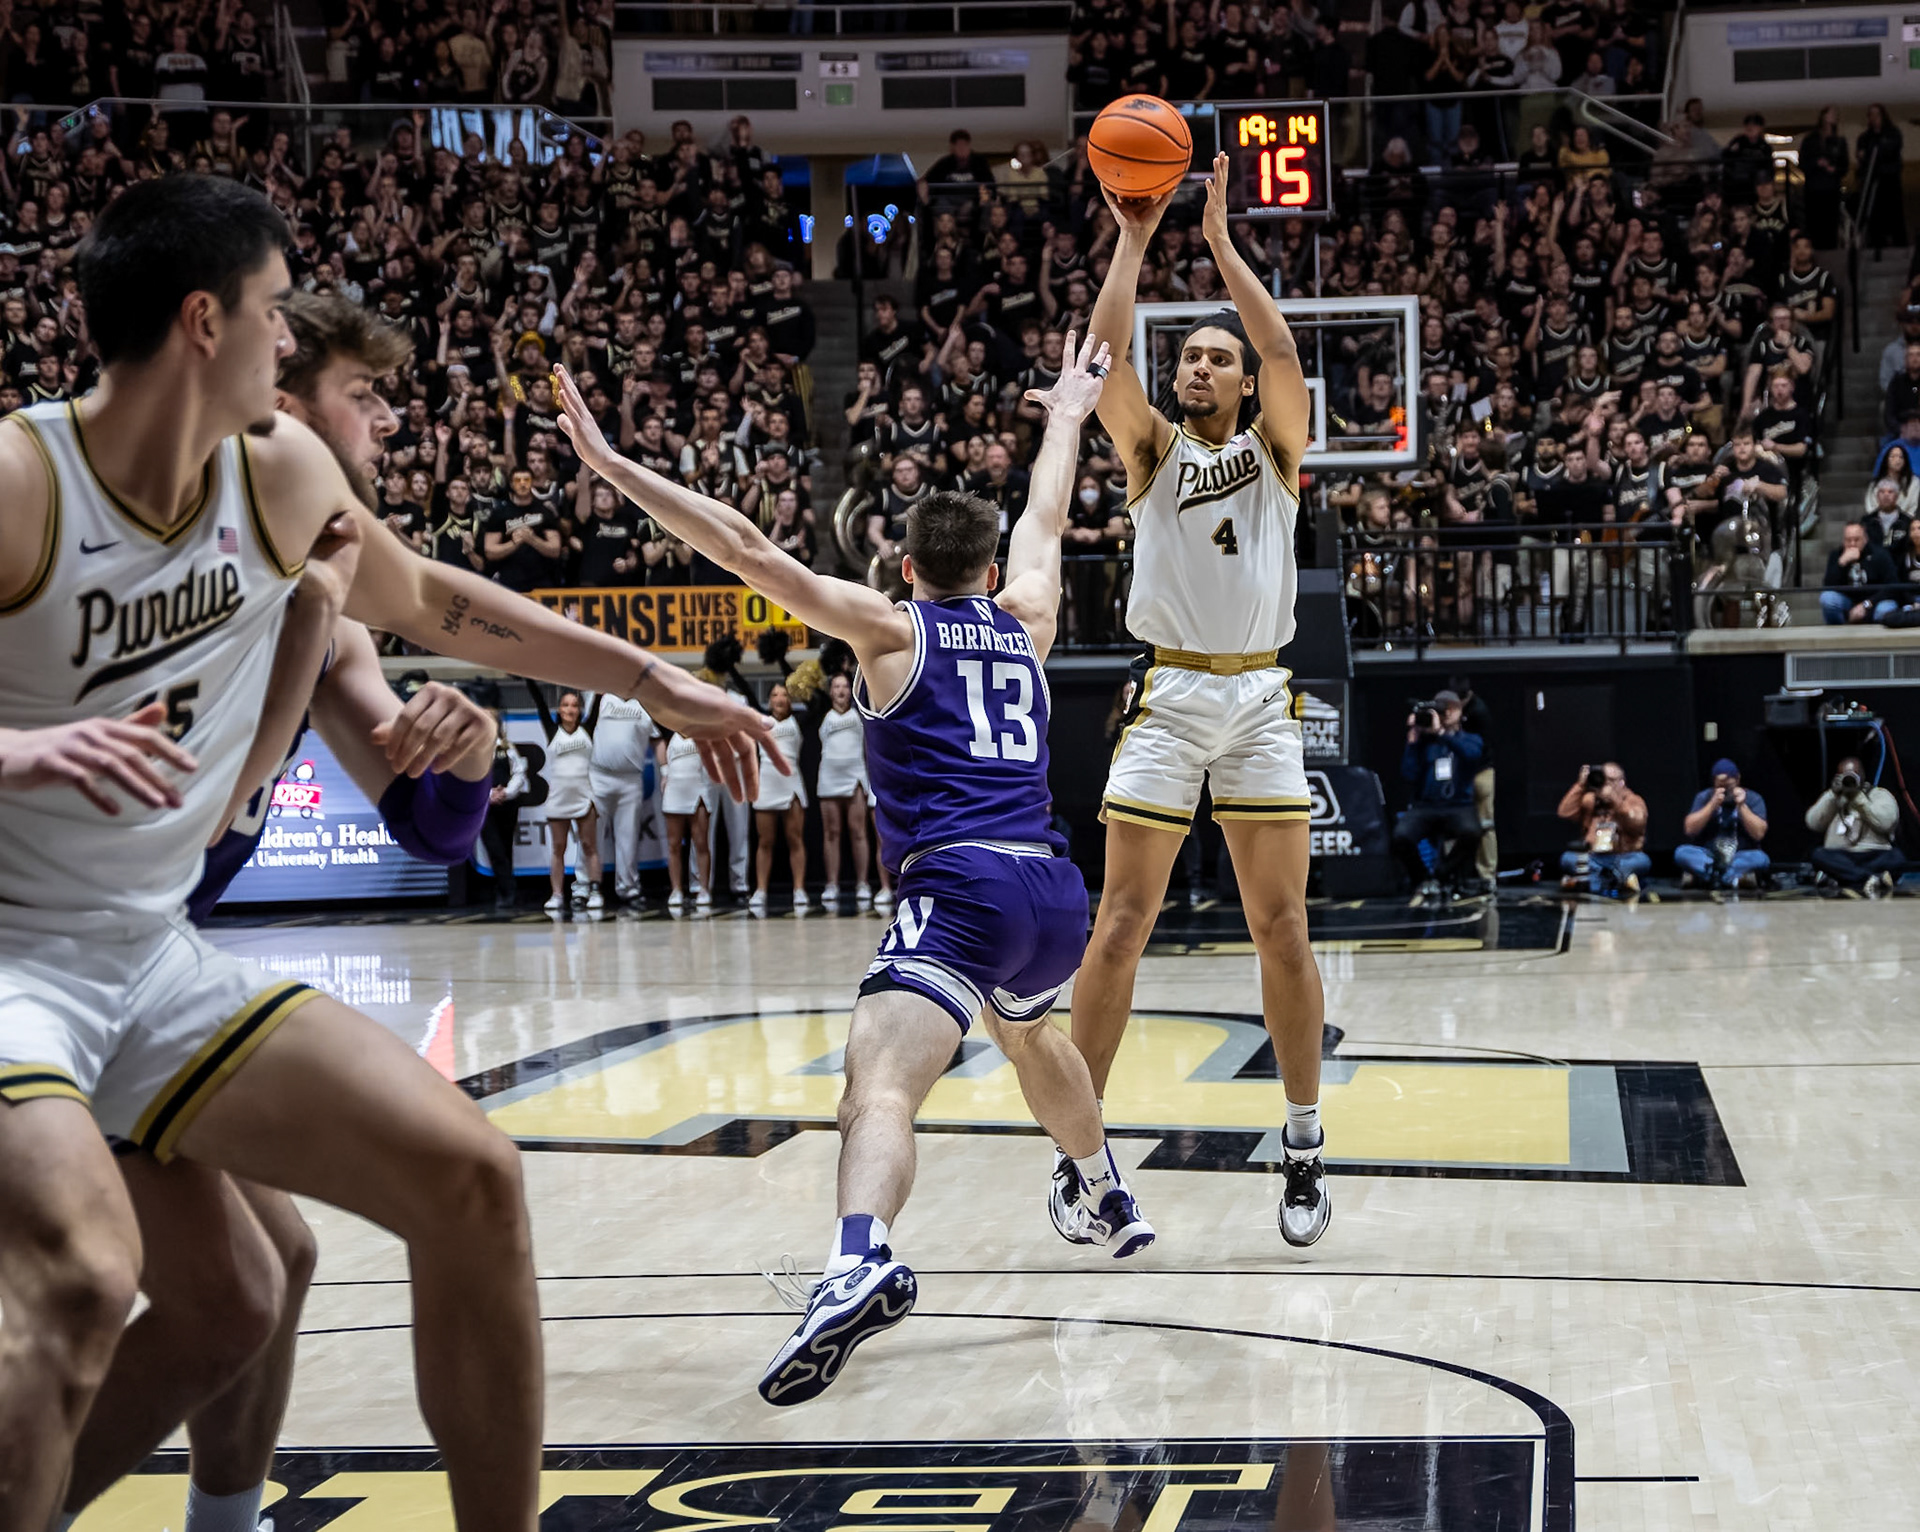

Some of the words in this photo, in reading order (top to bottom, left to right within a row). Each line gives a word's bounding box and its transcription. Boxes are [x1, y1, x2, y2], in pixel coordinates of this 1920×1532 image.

[1239, 113, 1318, 147] 19:14
[1259, 146, 1311, 206] 15
[1176, 448, 1261, 499] Purdue
[1211, 517, 1239, 555] 4
[70, 561, 245, 669] Purdue
[540, 593, 677, 647] ENSE
[680, 593, 737, 617] LIVES
[971, 599, 995, 626] N
[681, 619, 738, 647] HERE
[956, 659, 1039, 763] 13
[1303, 721, 1341, 736] DUE
[257, 825, 333, 849] ldren's
[338, 823, 398, 847] Healt
[1310, 830, 1361, 856] EER.
[257, 850, 327, 870] University
[330, 848, 379, 865] Health
